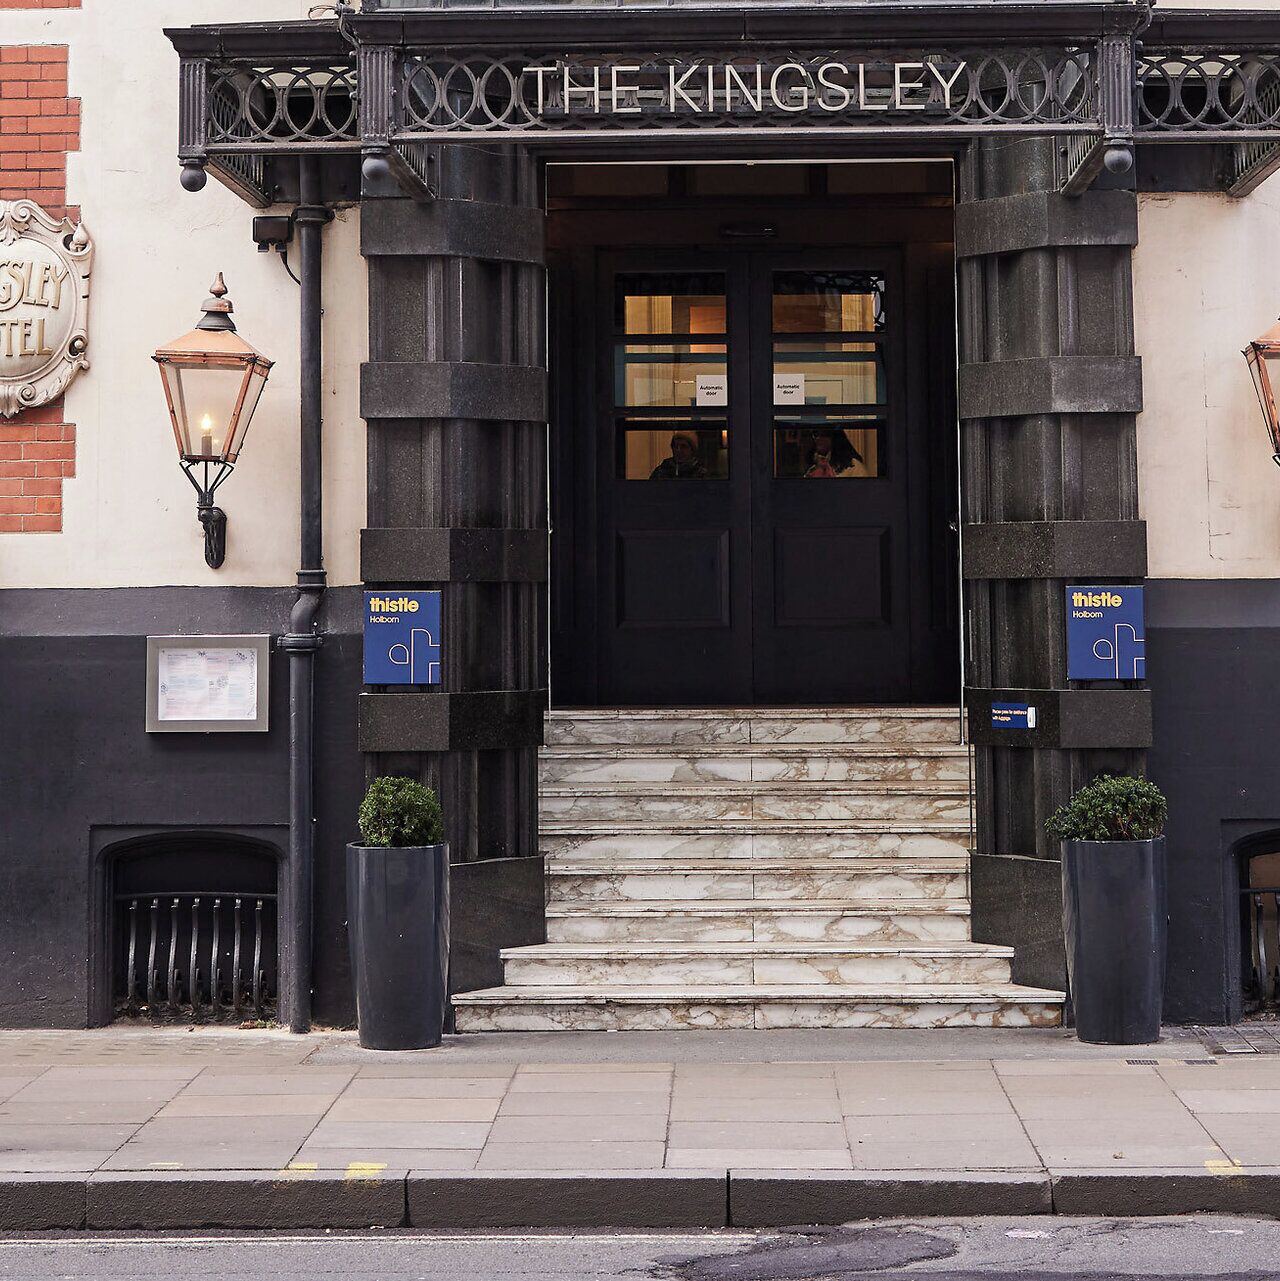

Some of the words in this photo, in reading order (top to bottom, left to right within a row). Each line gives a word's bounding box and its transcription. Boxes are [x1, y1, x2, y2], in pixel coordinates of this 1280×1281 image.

[522, 66, 642, 114] THE
[669, 61, 967, 112] KINGSLEY
[369, 597, 419, 613] thistle
[1072, 592, 1123, 607] thistle
[369, 616, 400, 624] Holborn
[1072, 610, 1103, 618] Holborn
